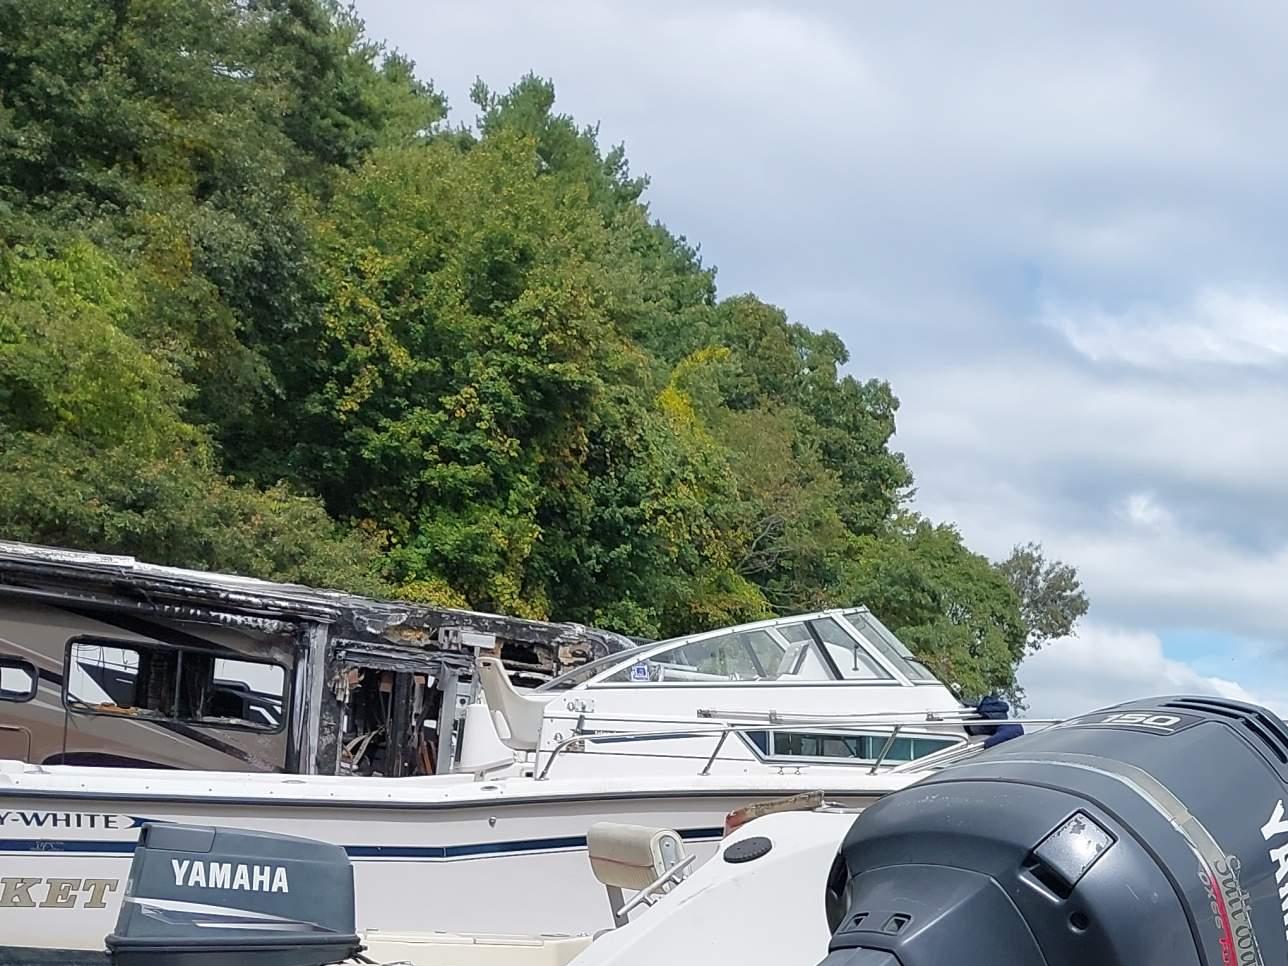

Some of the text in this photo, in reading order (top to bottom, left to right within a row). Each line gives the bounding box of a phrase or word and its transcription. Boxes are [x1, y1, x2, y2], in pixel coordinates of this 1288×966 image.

[1102, 713, 1181, 726] 150
[171, 859, 289, 893] YAMAHA
[0, 877, 119, 908] KET
